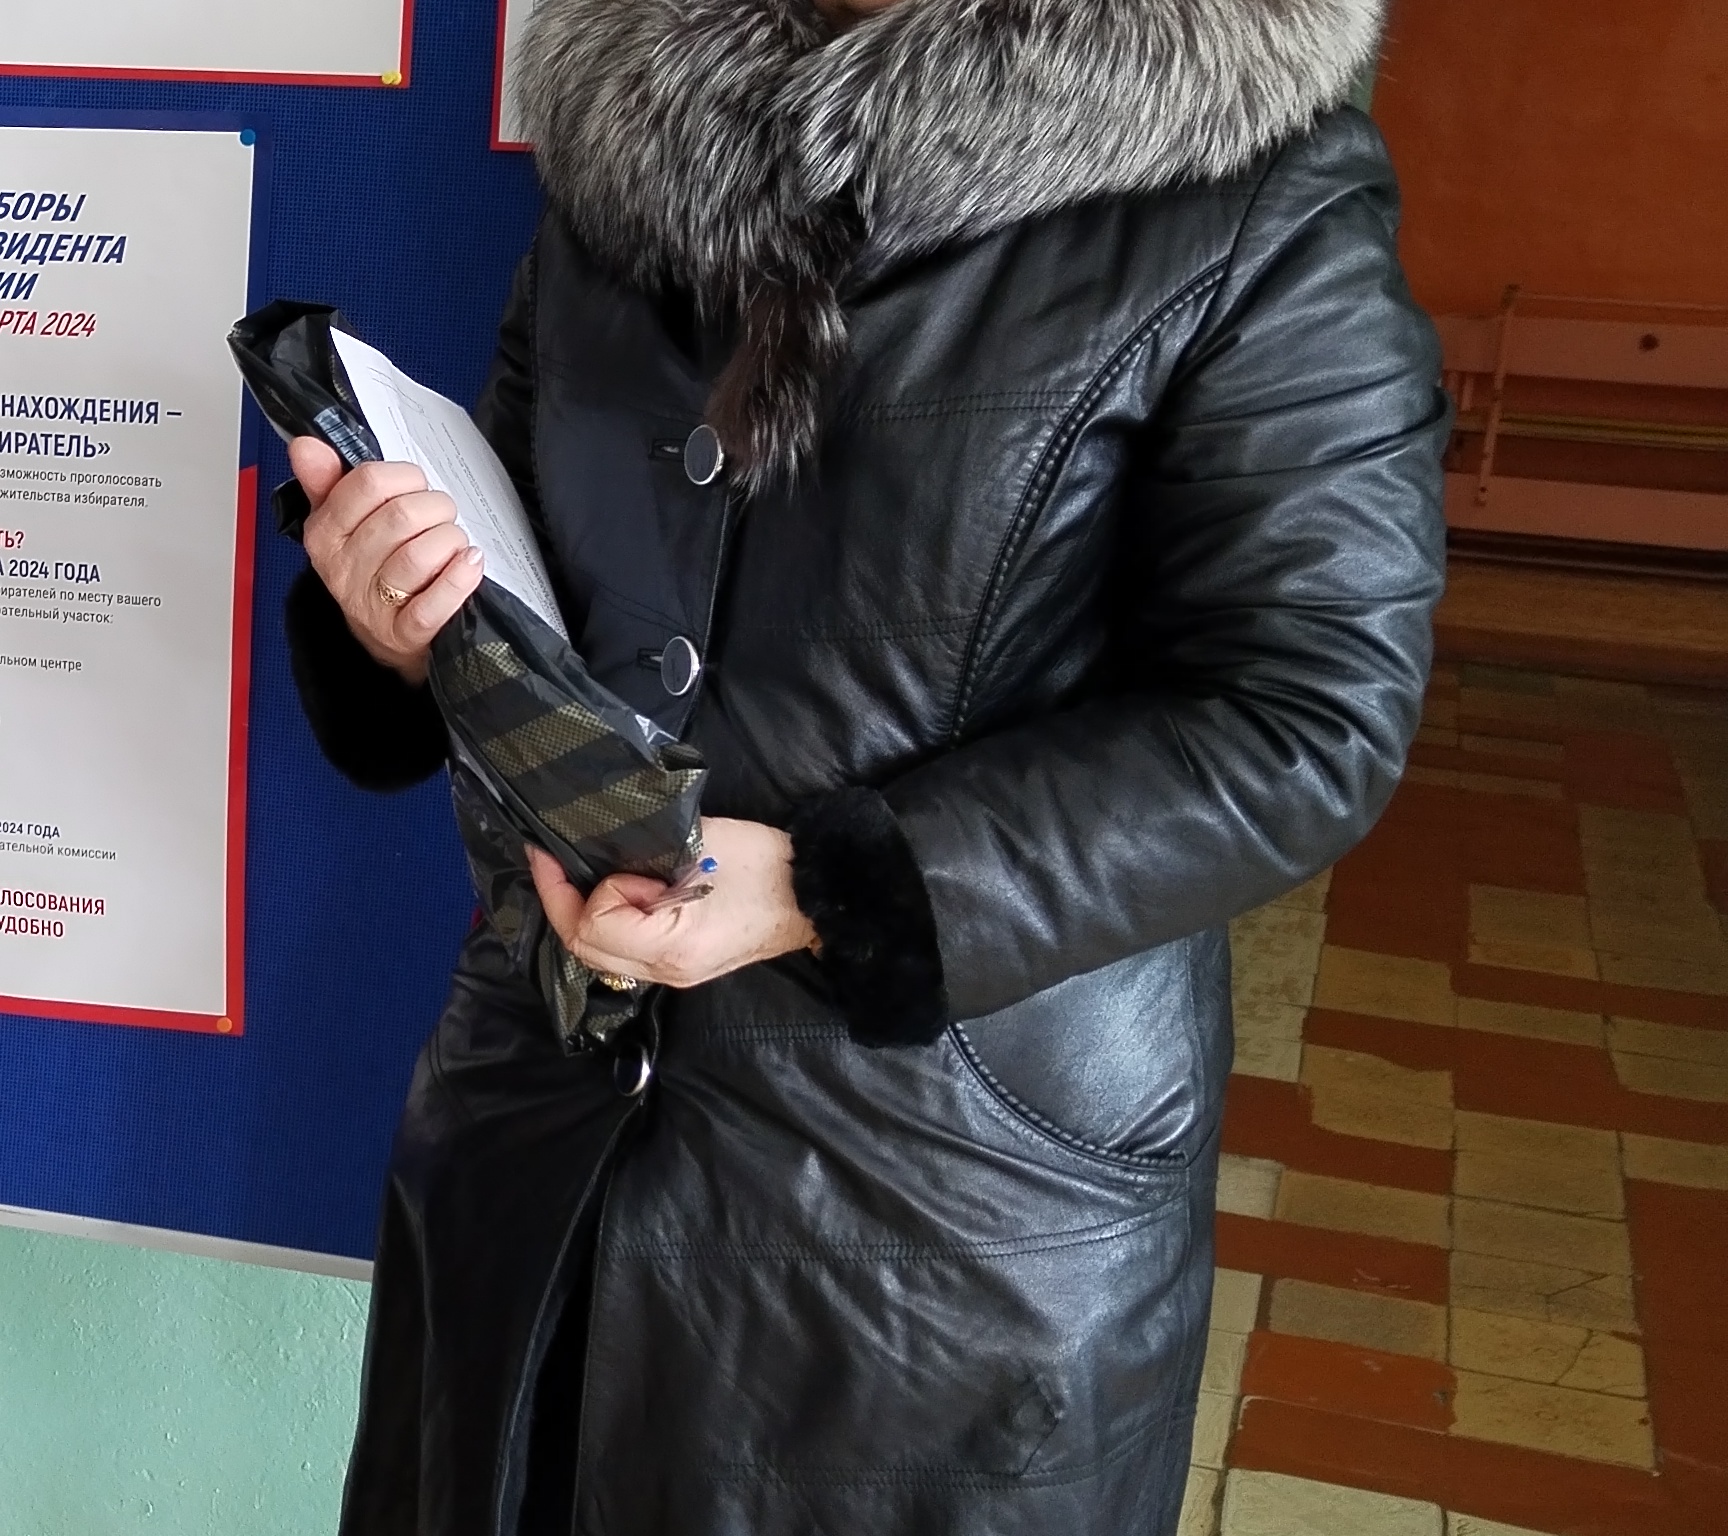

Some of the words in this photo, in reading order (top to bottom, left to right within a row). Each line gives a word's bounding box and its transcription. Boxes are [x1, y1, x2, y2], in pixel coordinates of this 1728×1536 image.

[39, 312, 97, 337] 2024
[1, 395, 159, 424] НАХОЖДЕНИЯ
[70, 473, 162, 488] проголосовать
[0, 489, 71, 503] жительства
[74, 491, 149, 508] избирателя.
[8, 559, 50, 579] 2024
[54, 562, 101, 584] ГОДА
[59, 590, 75, 601] по
[77, 592, 114, 607] месту
[116, 594, 162, 607] вашего
[40, 659, 82, 673] центре
[27, 823, 60, 840] ГОДА
[57, 847, 116, 860] комиссии
